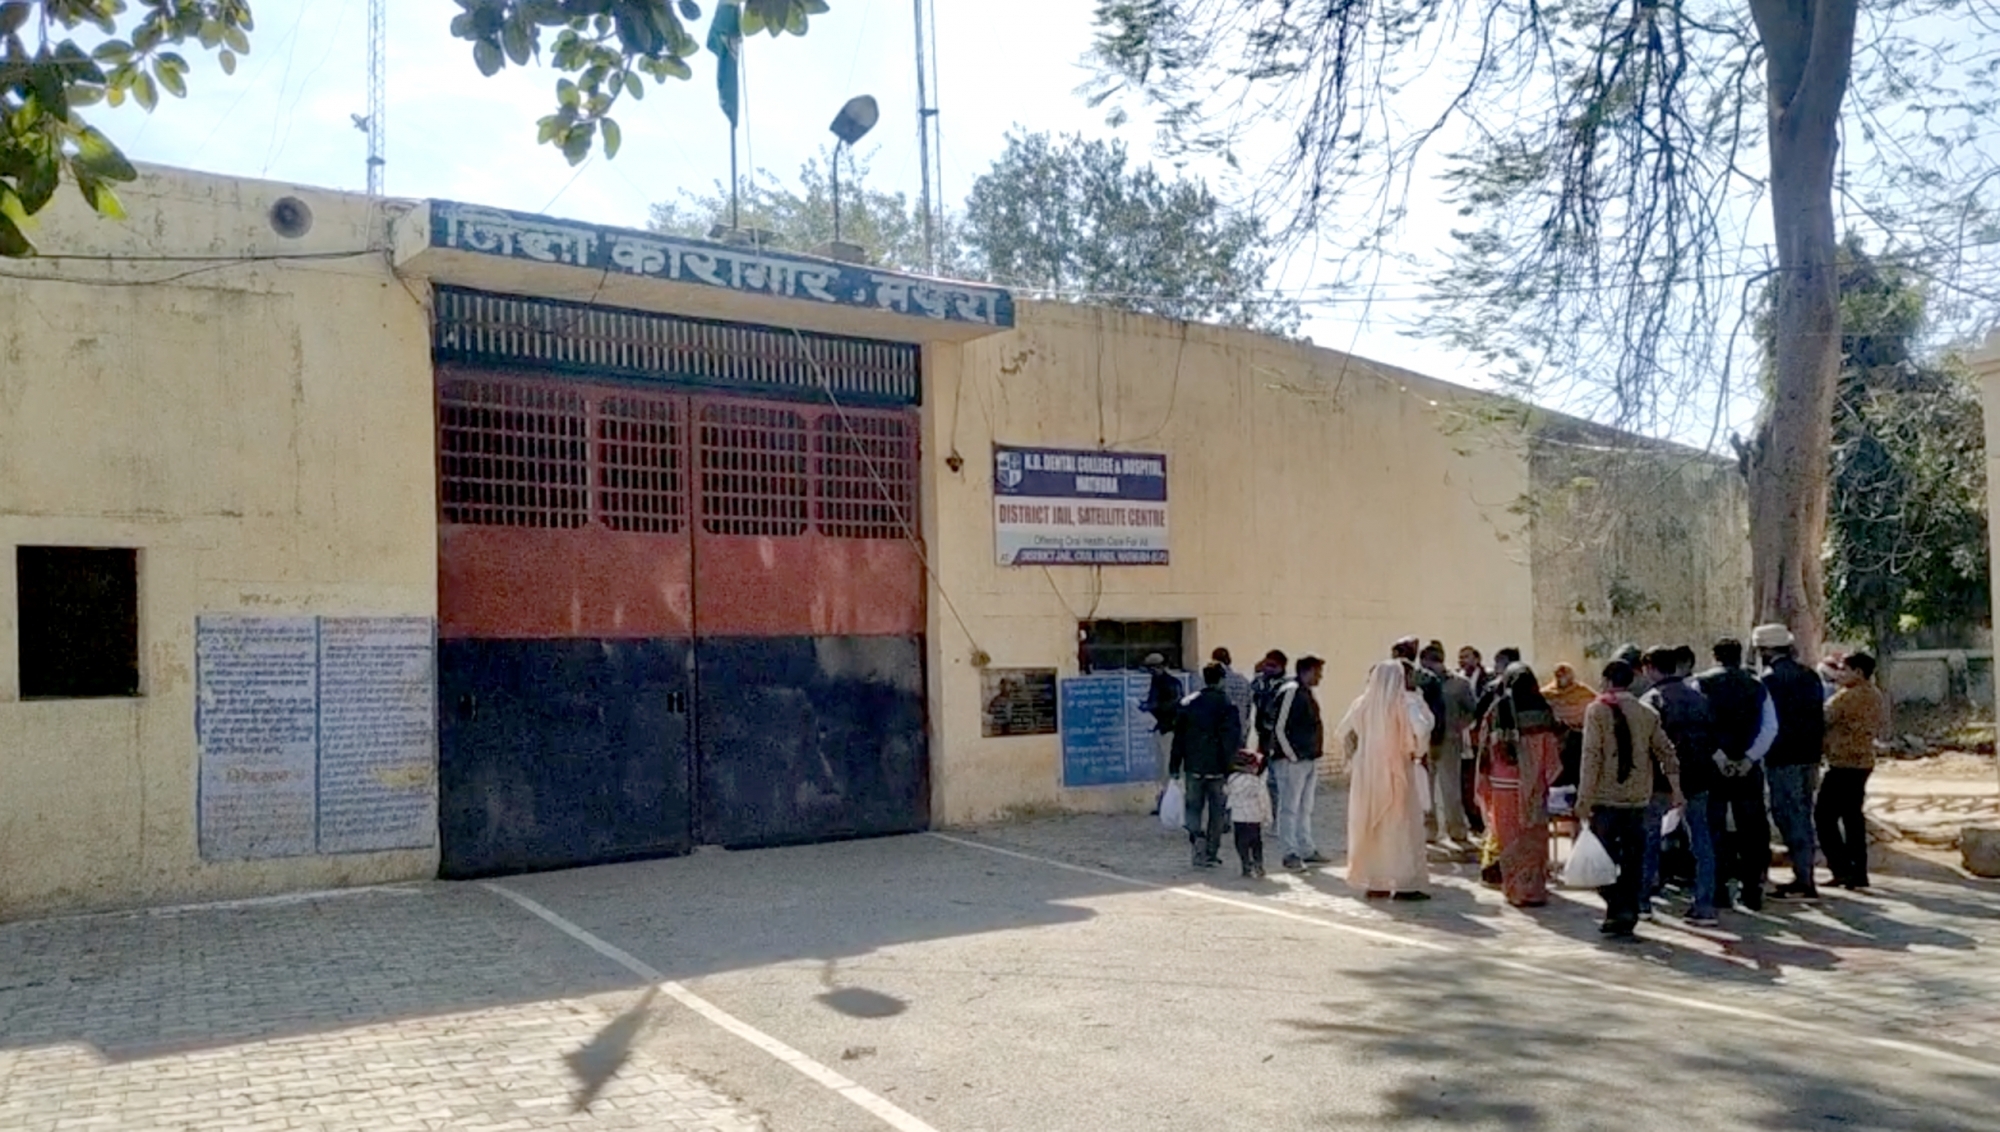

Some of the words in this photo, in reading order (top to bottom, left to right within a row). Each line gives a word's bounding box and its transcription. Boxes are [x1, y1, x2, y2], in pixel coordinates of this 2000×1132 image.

[605, 232, 841, 302] कारागार
[1043, 454, 1076, 472] DENTAL
[1077, 455, 1114, 474] COLLEGE
[1114, 459, 1121, 474] &
[999, 504, 1050, 525] DISTRICT
[1052, 506, 1076, 527] JAIL,
[1078, 506, 1127, 527] SATELLITE
[1128, 509, 1166, 528] CENTRE
[1034, 534, 1063, 548] Offering
[1125, 537, 1138, 546] For
